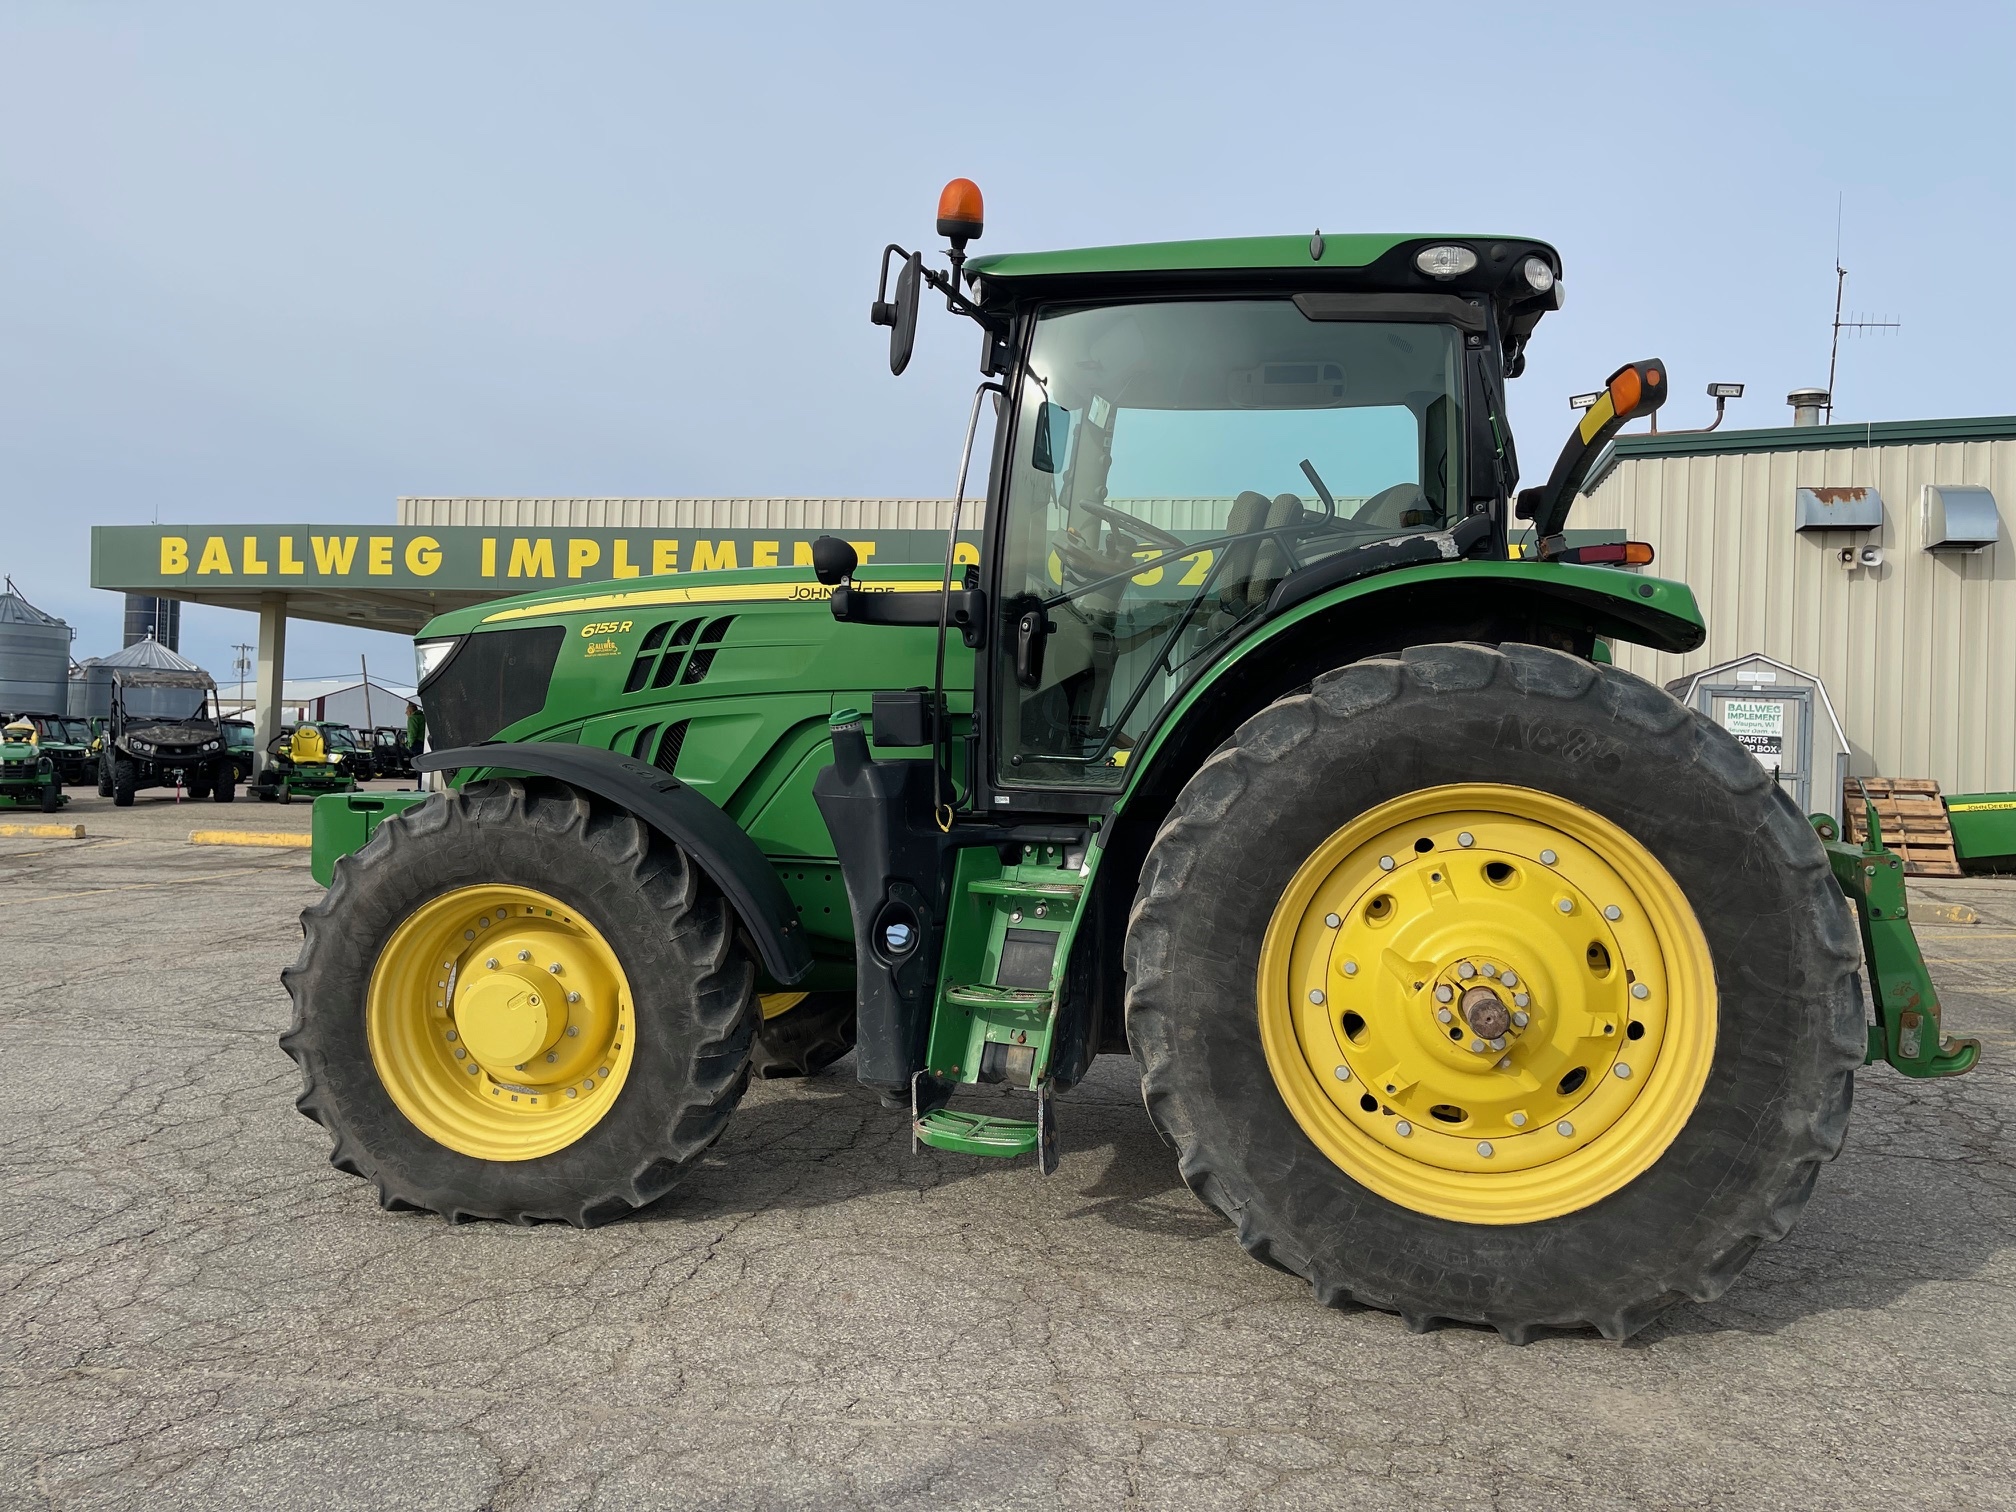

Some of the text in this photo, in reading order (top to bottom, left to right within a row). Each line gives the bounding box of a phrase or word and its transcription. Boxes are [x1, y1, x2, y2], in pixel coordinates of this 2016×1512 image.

[160, 536, 876, 579] BALLWEG IMPLEME
[1728, 703, 1781, 713] BALLWEG
[1727, 712, 1781, 721] IMPLEMENT
[1738, 735, 1768, 744] PARTS
[1757, 745, 1777, 754] BOX
